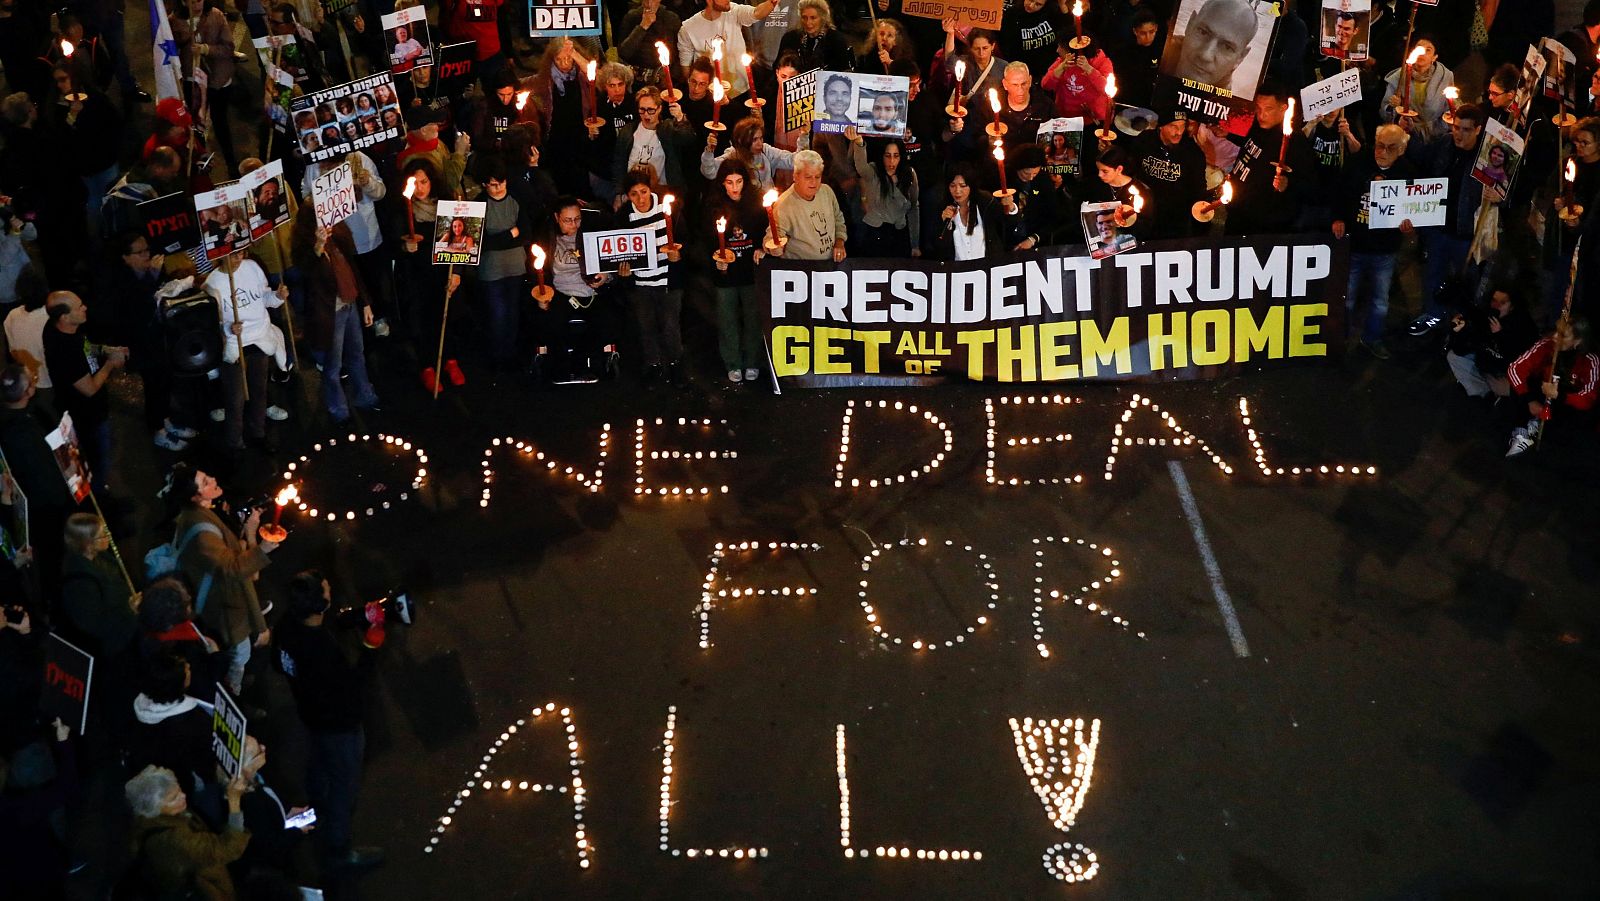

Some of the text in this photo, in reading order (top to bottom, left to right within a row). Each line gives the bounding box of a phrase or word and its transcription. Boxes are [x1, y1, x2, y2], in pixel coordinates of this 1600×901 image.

[535, 7, 595, 29] DEAL
[904, 1, 944, 16] פחות
[440, 60, 471, 79] הצילו
[312, 73, 390, 107] זועקות בשבילן
[1182, 77, 1233, 99] הופקר למוות בשבי
[1177, 91, 1230, 121] אלעד קציר
[820, 122, 840, 133] BRING
[310, 127, 398, 162] עסקה היום!
[315, 163, 350, 195] STOP
[323, 183, 340, 197] THE
[1381, 183, 1443, 199] IN TRUMP
[316, 184, 354, 219] BLOODY
[1378, 204, 1395, 216] WE
[1402, 200, 1440, 214] TRUST
[146, 211, 191, 238] הצילו
[450, 253, 471, 263] עסקה
[601, 236, 643, 255] 468
[769, 244, 1332, 324] PRESIDENT TRUMP
[771, 302, 1328, 383] GET ALL OF THEM HOME
[283, 394, 1377, 521] ONE DEAL
[700, 535, 1148, 659] FOR
[47, 661, 84, 702] הצילו
